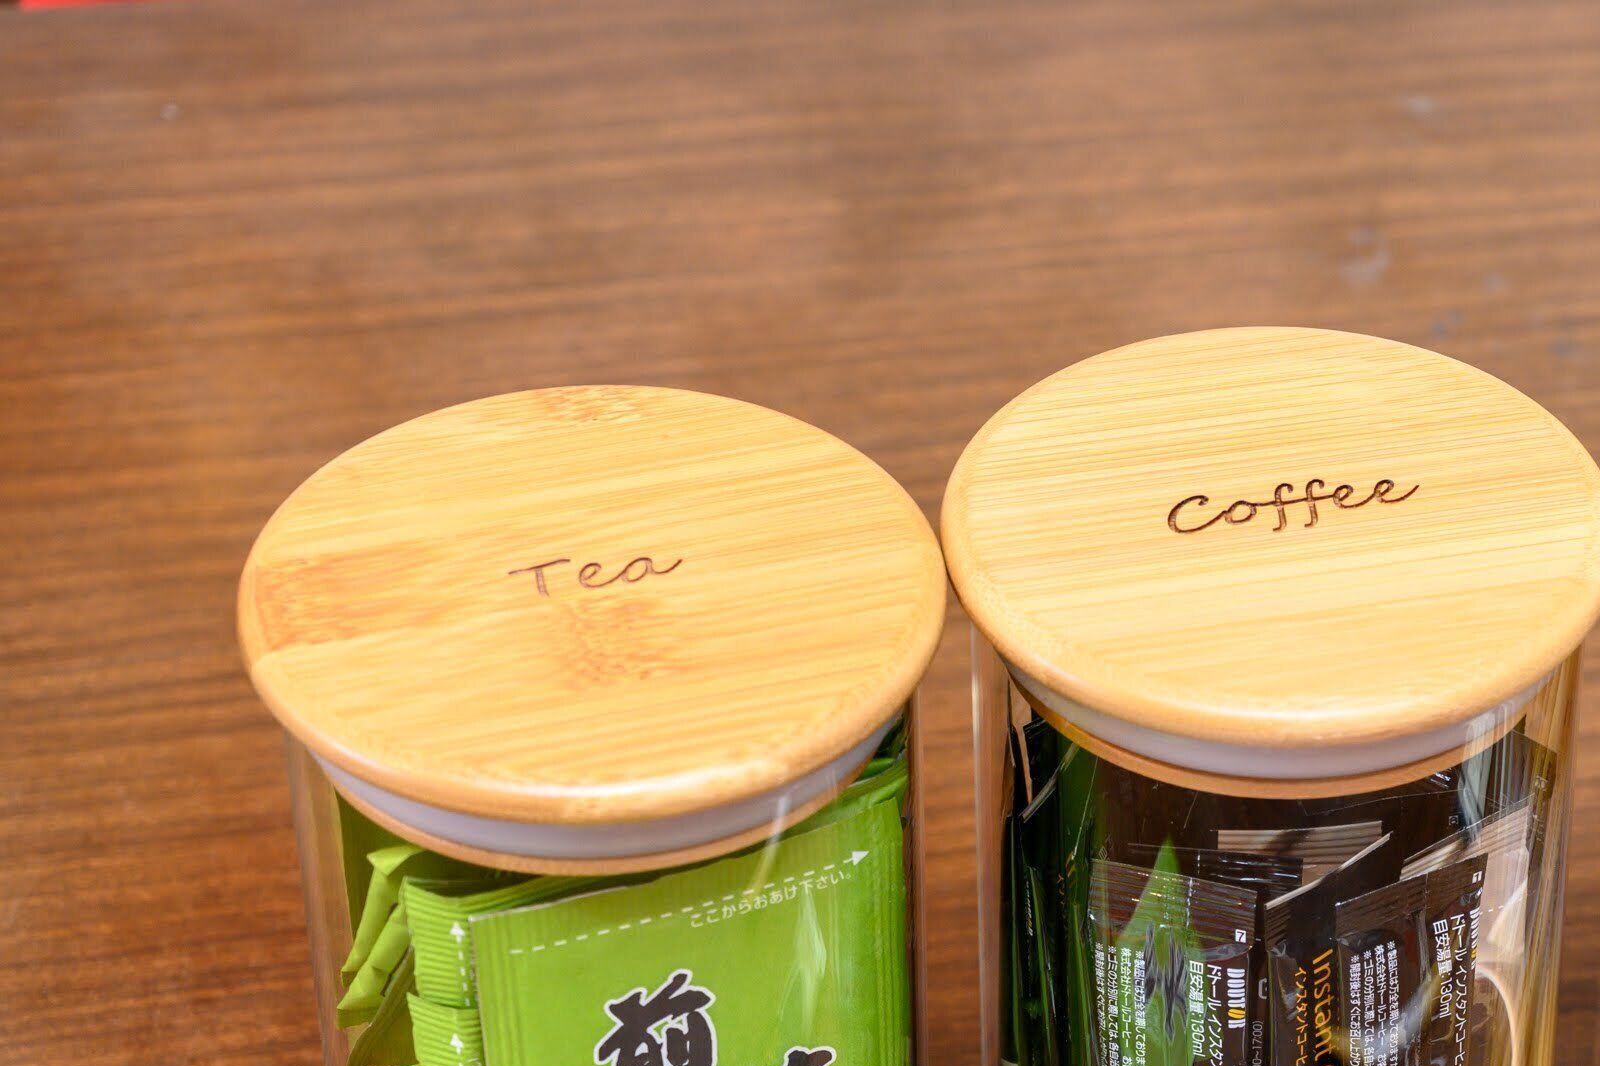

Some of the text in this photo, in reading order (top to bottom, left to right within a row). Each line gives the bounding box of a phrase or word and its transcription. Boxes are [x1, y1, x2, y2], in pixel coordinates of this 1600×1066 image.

[1167, 478, 1420, 534] Coffee
[508, 556, 684, 598] Tea
[690, 872, 852, 928] ここからおあけ下さい。
[1450, 914, 1464, 961] ドトール
[1189, 960, 1206, 1057] 目安湯量:130ml
[1208, 964, 1221, 1011] ドトール
[1226, 968, 1247, 1028] DOUTOR
[1312, 949, 1335, 1060] Instant
